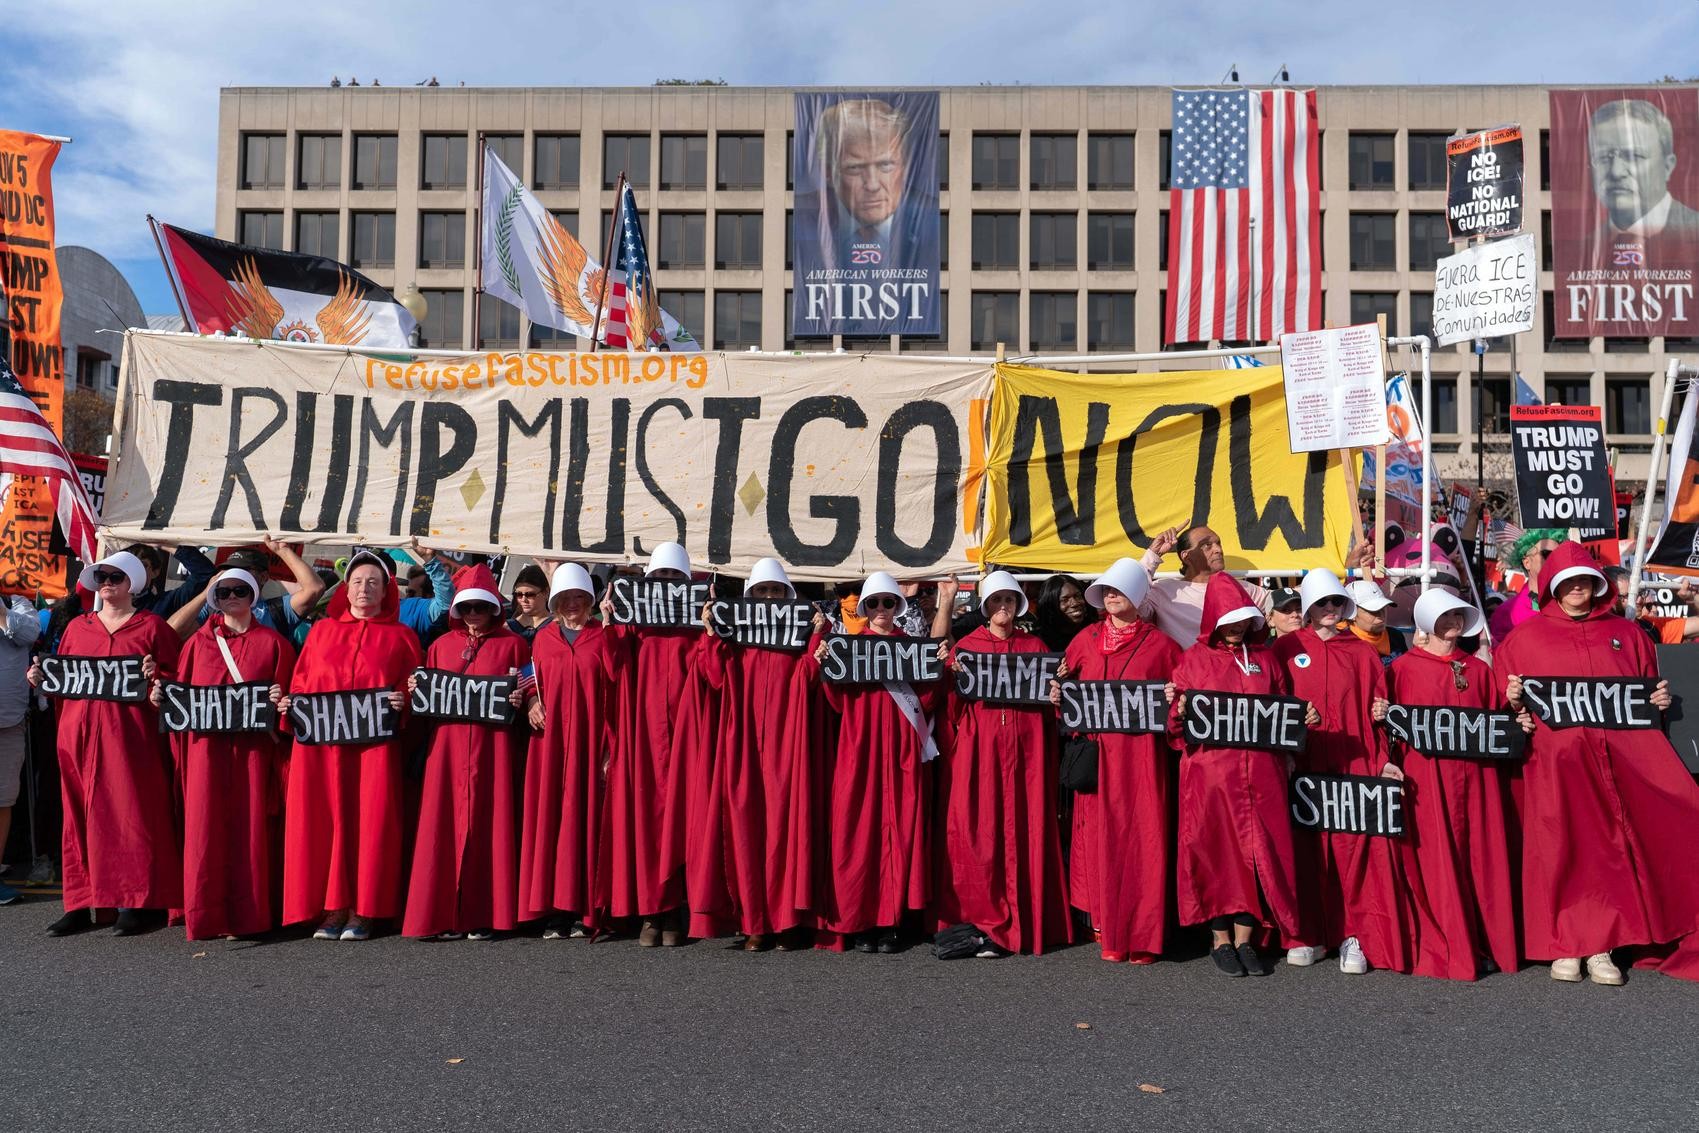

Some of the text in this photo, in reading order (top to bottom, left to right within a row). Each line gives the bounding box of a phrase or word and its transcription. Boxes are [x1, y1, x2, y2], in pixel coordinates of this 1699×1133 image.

[17, 155, 28, 188] 5
[1467, 165, 1500, 183] ICE!
[1471, 152, 1497, 168] NO
[1450, 195, 1519, 219] NATIONAL
[1472, 185, 1494, 200] NO
[1458, 210, 1510, 231] GUARD!
[806, 268, 928, 280] AMERICAN WORKERS
[1489, 253, 1526, 282] ICE
[1567, 269, 1692, 281] AMERICAN WORKERS
[805, 282, 929, 320] FIRST
[1566, 283, 1693, 322] FIRST
[365, 352, 707, 390] refusefascism.org
[1516, 407, 1594, 416] RefuseFascism.org
[1516, 427, 1599, 448] TRUMP
[143, 380, 478, 537] TRUMP
[490, 397, 761, 564] MUST
[1008, 394, 1326, 552] NOW
[1527, 449, 1594, 471] MUST
[1547, 473, 1583, 495] GO
[1537, 497, 1600, 519] NOW!
[613, 578, 706, 626] SHAME
[712, 601, 810, 647] SHAME
[42, 658, 138, 698] SHAME
[824, 637, 939, 681] SHAME
[957, 652, 1055, 700] SHAME
[165, 684, 269, 731] SHAME
[413, 671, 507, 721] SHAME
[1063, 682, 1164, 731] SHAME
[1523, 678, 1652, 726] SHAME
[292, 691, 394, 743] SHAME
[1187, 694, 1299, 746] SHAME
[1386, 704, 1510, 754] SHAME
[1293, 776, 1403, 834] SHAME
